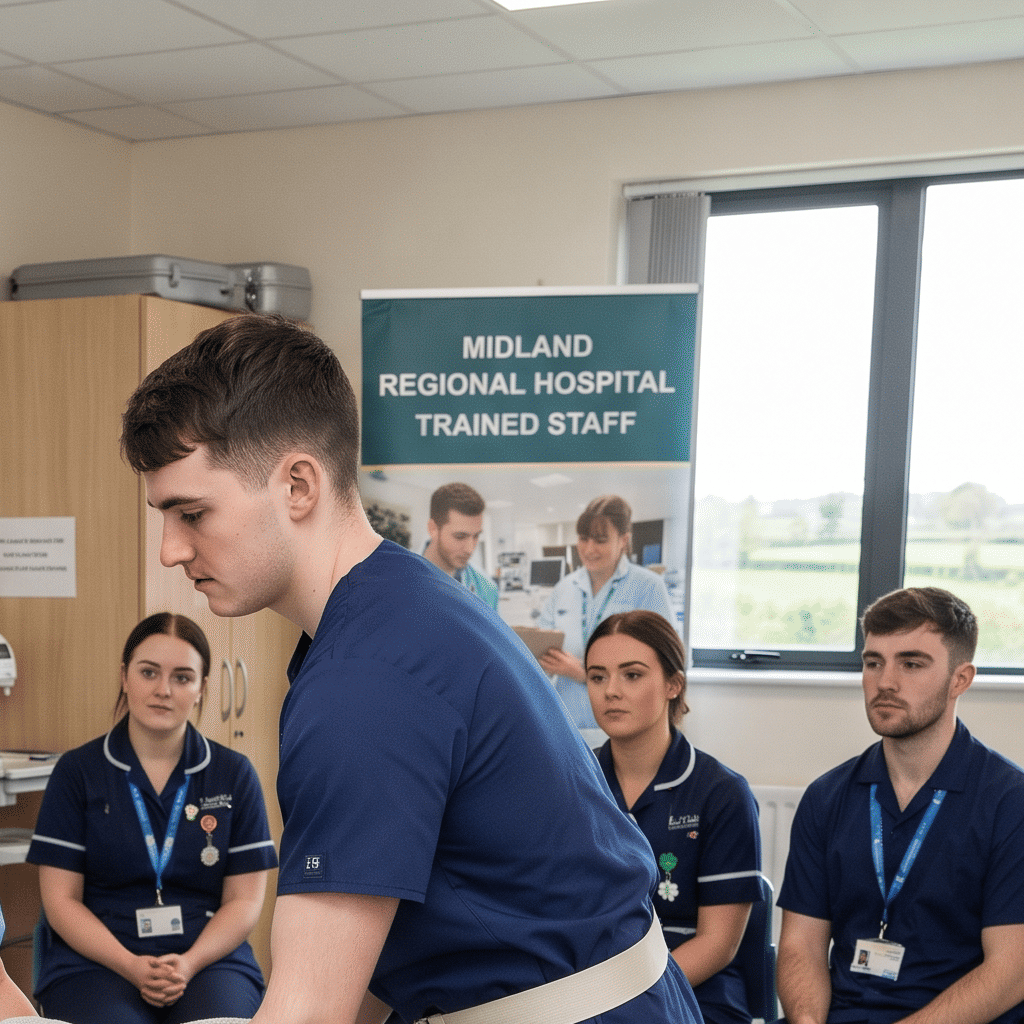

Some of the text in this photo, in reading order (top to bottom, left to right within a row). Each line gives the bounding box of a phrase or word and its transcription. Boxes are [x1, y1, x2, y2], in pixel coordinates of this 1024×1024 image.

[462, 334, 593, 359] MIDLAND
[379, 370, 676, 397] REGIONAL HOSPITAL
[415, 411, 636, 437] TRAINED STAFF
